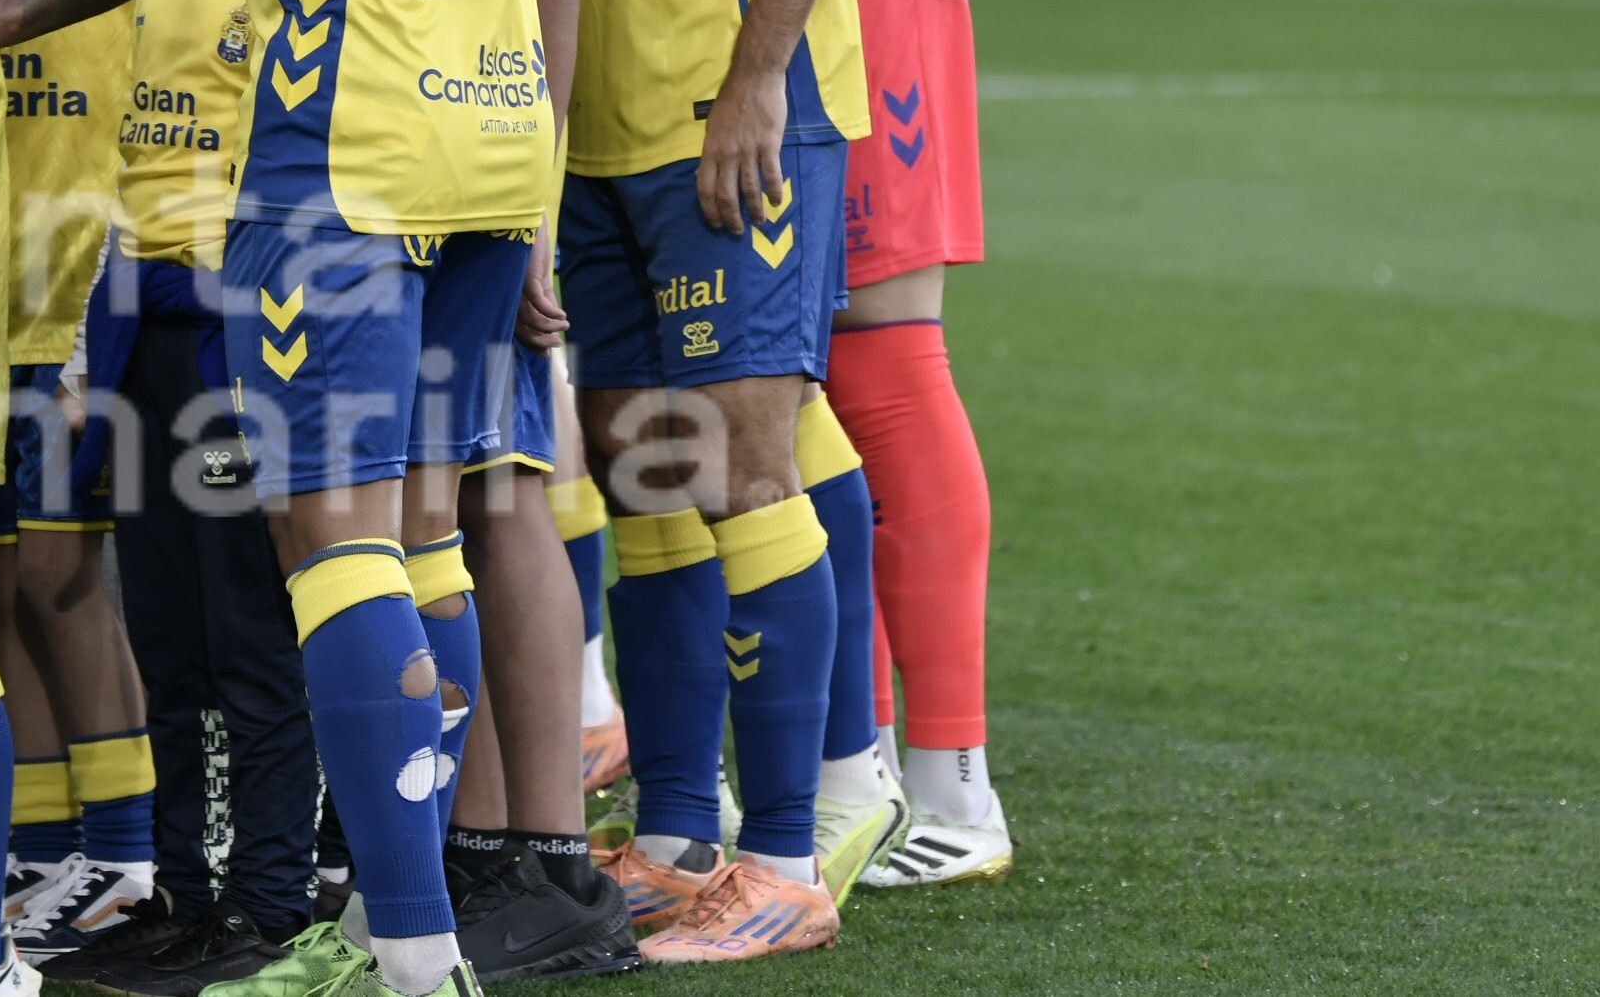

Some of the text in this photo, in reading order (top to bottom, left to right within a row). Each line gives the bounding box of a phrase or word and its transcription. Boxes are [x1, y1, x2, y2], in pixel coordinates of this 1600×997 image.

[479, 44, 527, 76] Islas
[134, 81, 196, 116] Gran
[419, 68, 534, 107] Canarias
[119, 114, 220, 152] Canaria
